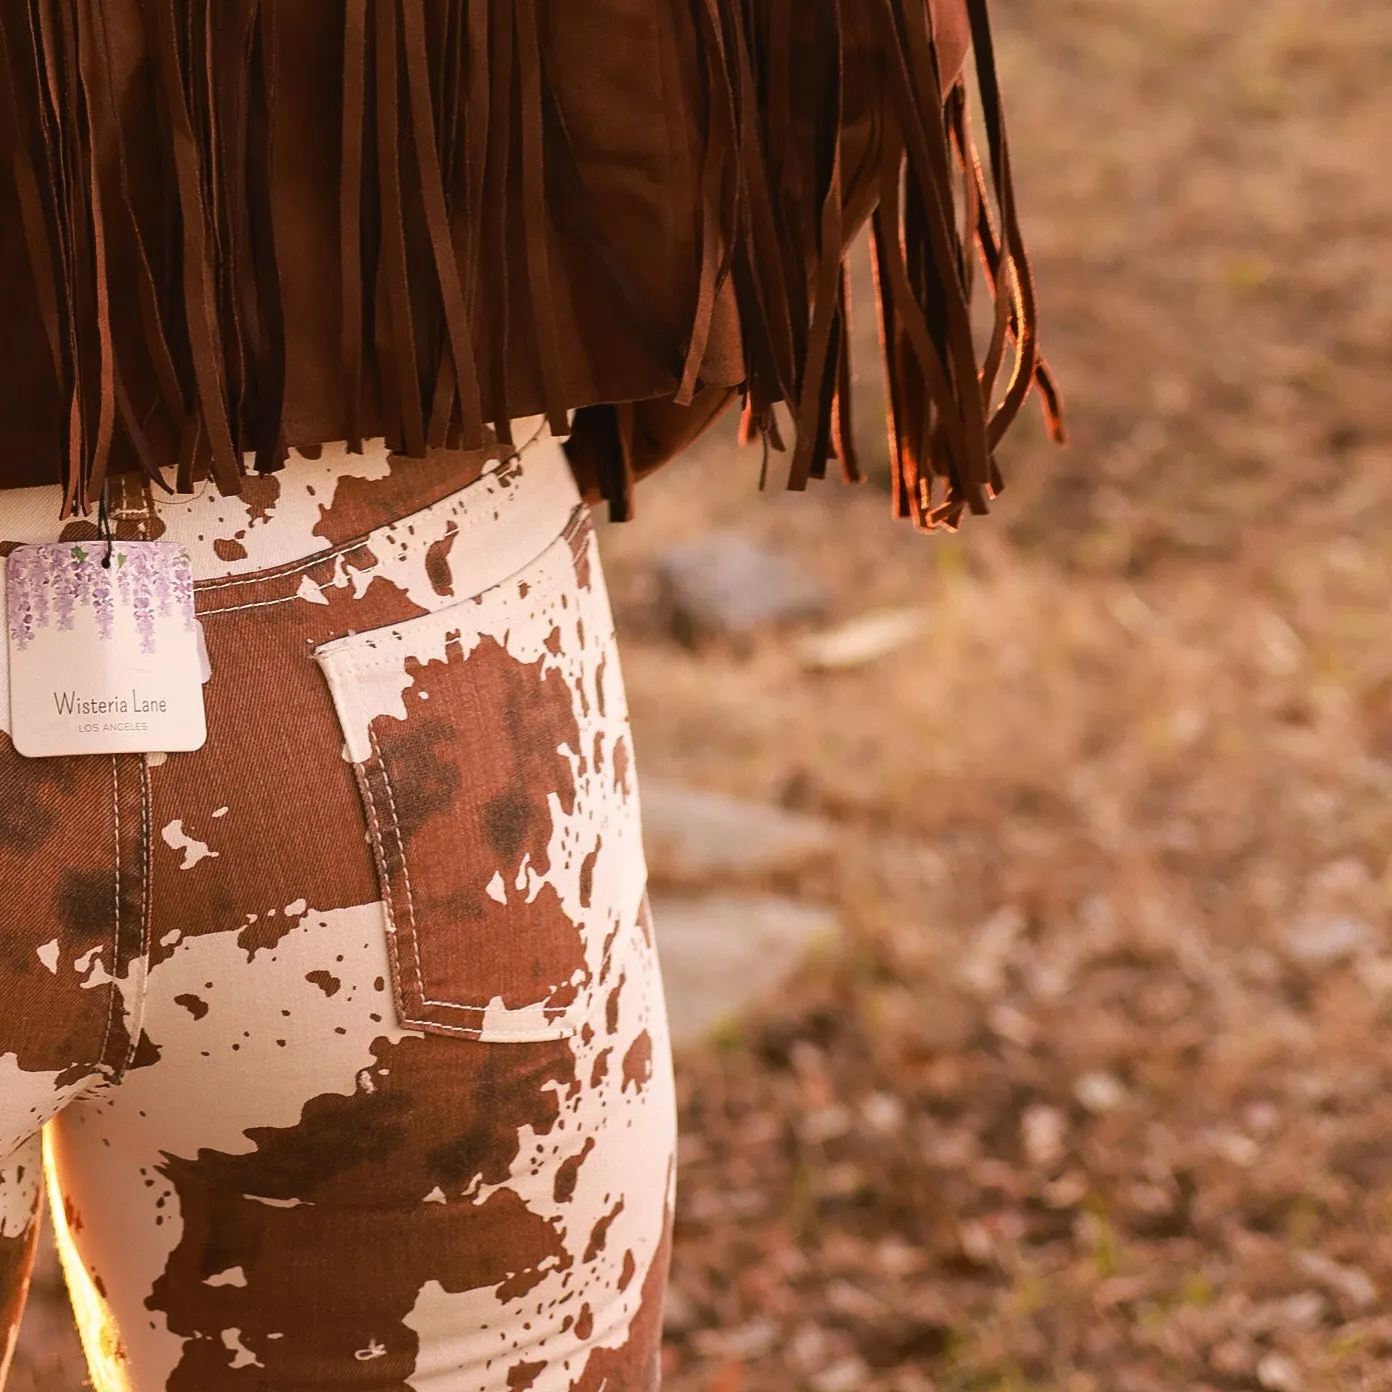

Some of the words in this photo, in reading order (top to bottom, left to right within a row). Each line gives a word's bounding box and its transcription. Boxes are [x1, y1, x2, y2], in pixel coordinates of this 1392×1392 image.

[53, 691, 128, 715] Wisteria
[132, 689, 167, 713] Lane
[78, 723, 100, 733] LOS
[102, 722, 148, 732] ANGELES
